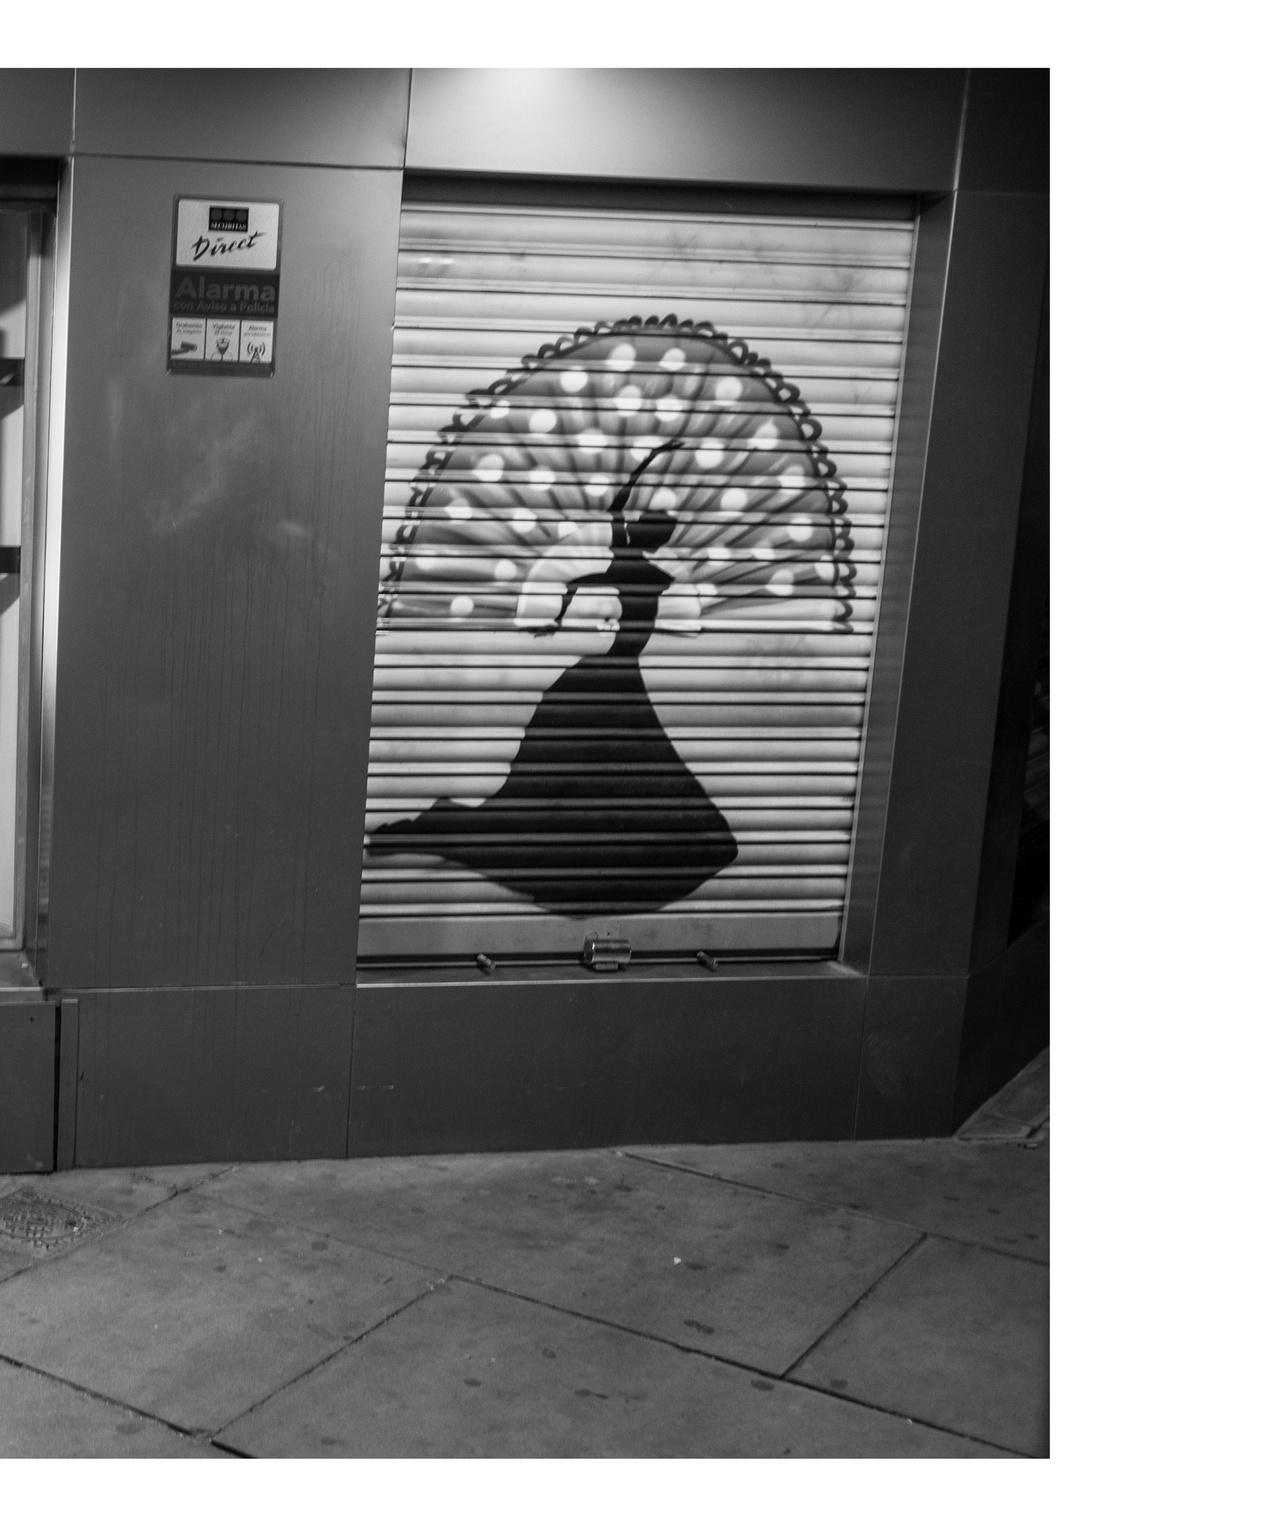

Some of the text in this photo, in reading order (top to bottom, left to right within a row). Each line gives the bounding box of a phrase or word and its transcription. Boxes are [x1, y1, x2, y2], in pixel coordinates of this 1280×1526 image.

[192, 231, 267, 261] Direct
[175, 275, 275, 302] Alarma
[174, 302, 194, 311] con
[197, 300, 227, 312] Aviso
[230, 304, 237, 312] a
